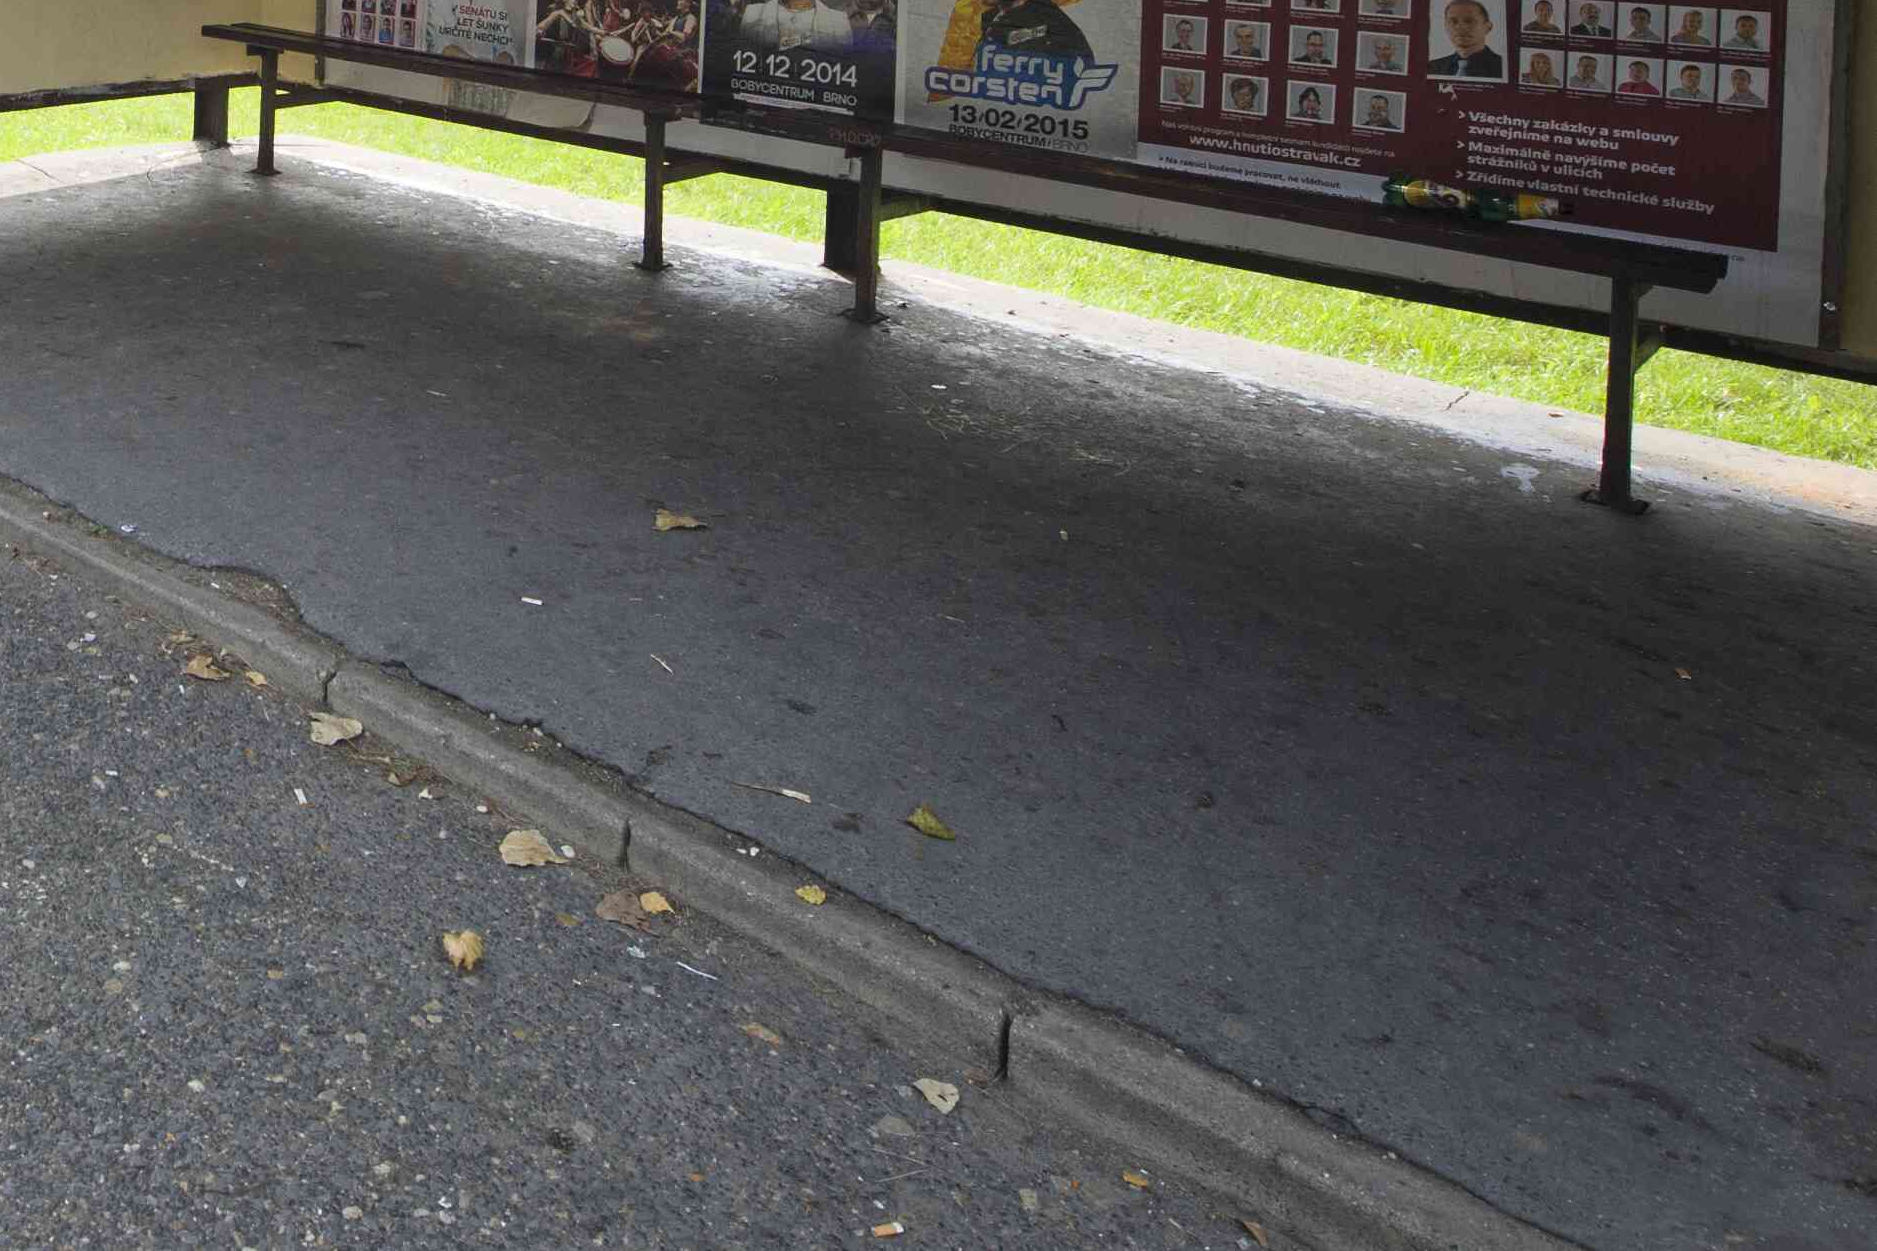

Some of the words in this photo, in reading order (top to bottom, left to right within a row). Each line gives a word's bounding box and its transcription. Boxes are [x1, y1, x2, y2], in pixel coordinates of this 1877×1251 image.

[733, 49, 757, 73] 12
[766, 54, 791, 78] 12
[800, 59, 858, 87] 2014
[980, 45, 1064, 83] ferry
[731, 79, 815, 101] BOBYCENTRUM
[823, 91, 858, 106] BRNO
[927, 69, 1063, 106] corsten
[948, 103, 1090, 140] 13/02/2015
[1467, 111, 1530, 129] Všechny
[1533, 117, 1596, 137] zakázky
[1599, 128, 1609, 137] a
[1612, 128, 1680, 147] smlouvy
[1467, 123, 1550, 142] zveřejníme
[1553, 134, 1573, 145] na
[1576, 137, 1620, 151] webu
[1189, 134, 1362, 168] www.hnutiostravak.cz
[1208, 160, 1243, 175] budeme
[1468, 141, 1551, 161] Maximálně
[1554, 150, 1627, 170] navýšíme
[1631, 158, 1676, 176] počet
[1540, 163, 1550, 172] v
[1466, 170, 1525, 189] Zřídíme
[1527, 178, 1579, 195] vlastní
[1582, 184, 1660, 206] technické
[1662, 195, 1715, 215] služby
